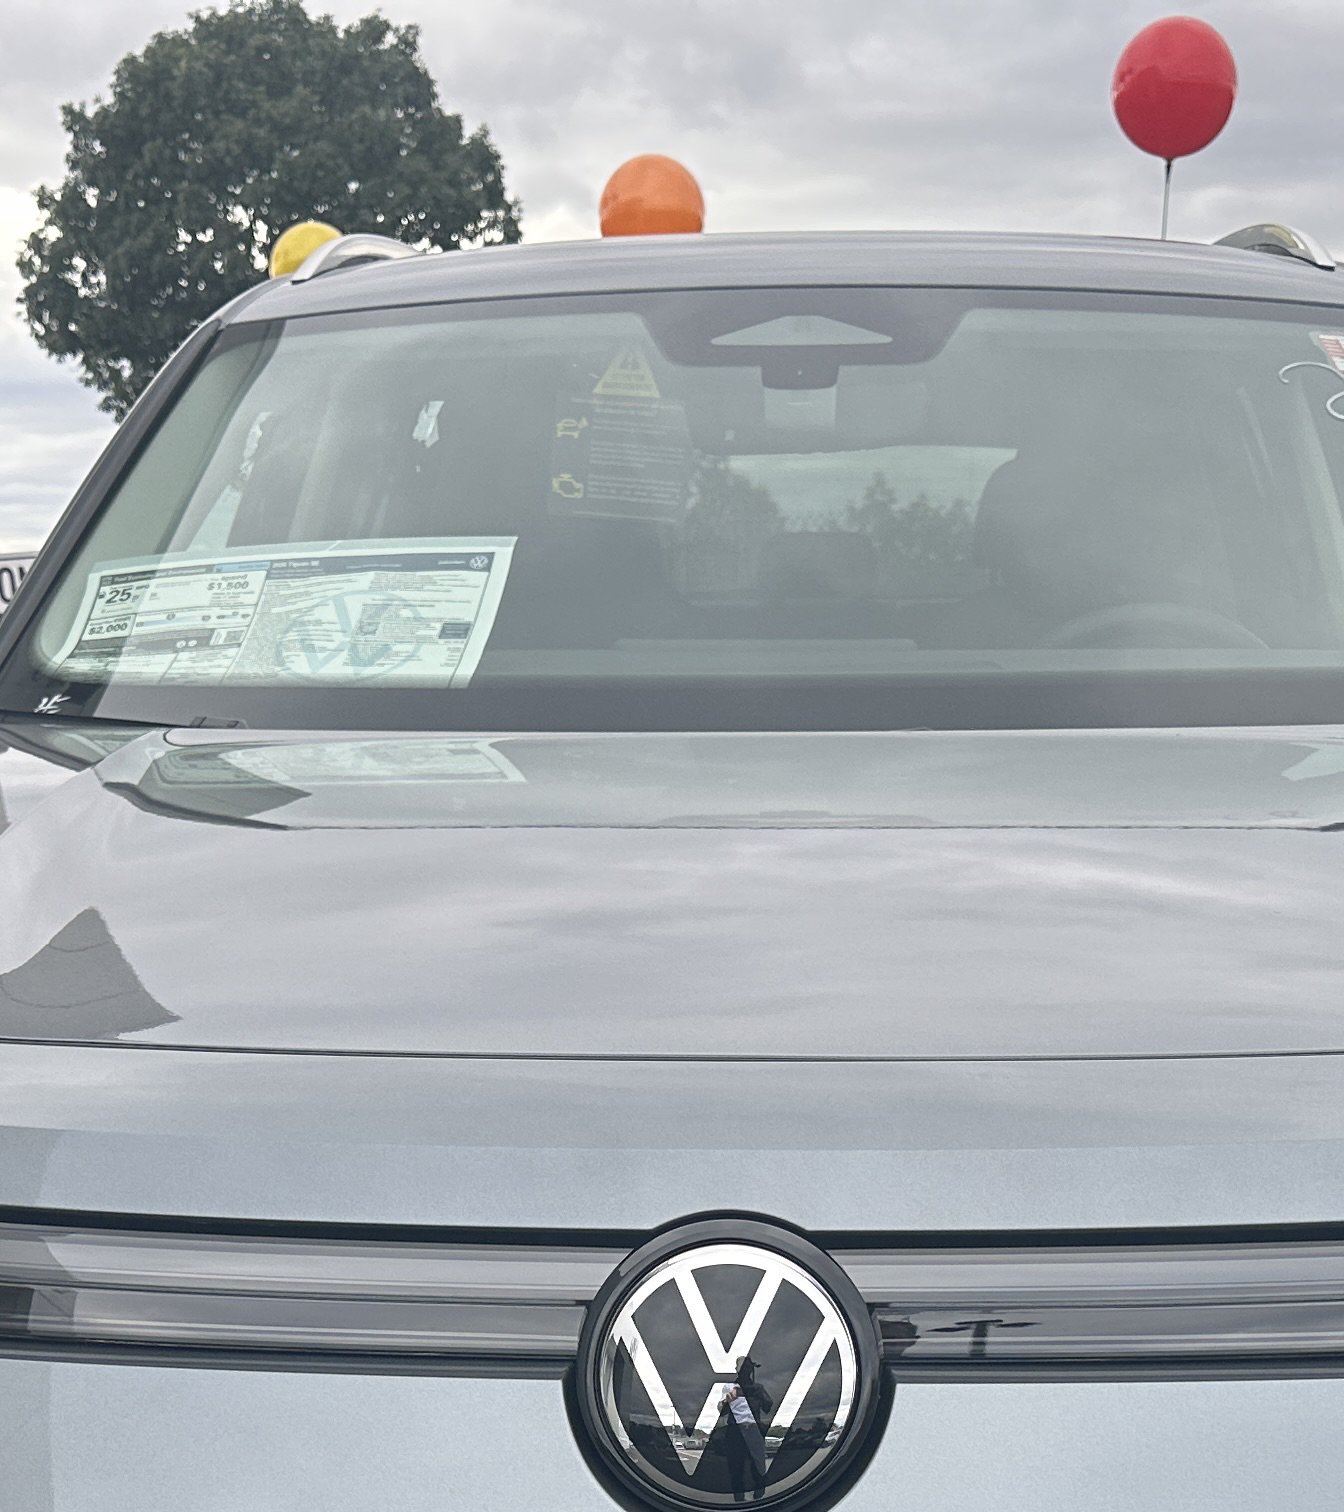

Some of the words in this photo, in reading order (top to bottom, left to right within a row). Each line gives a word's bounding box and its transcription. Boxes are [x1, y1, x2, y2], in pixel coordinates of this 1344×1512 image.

[207, 581, 250, 591] $1,500
[105, 587, 132, 604] 25
[88, 622, 128, 635] $2,000
[600, 1243, 857, 1505] VW
